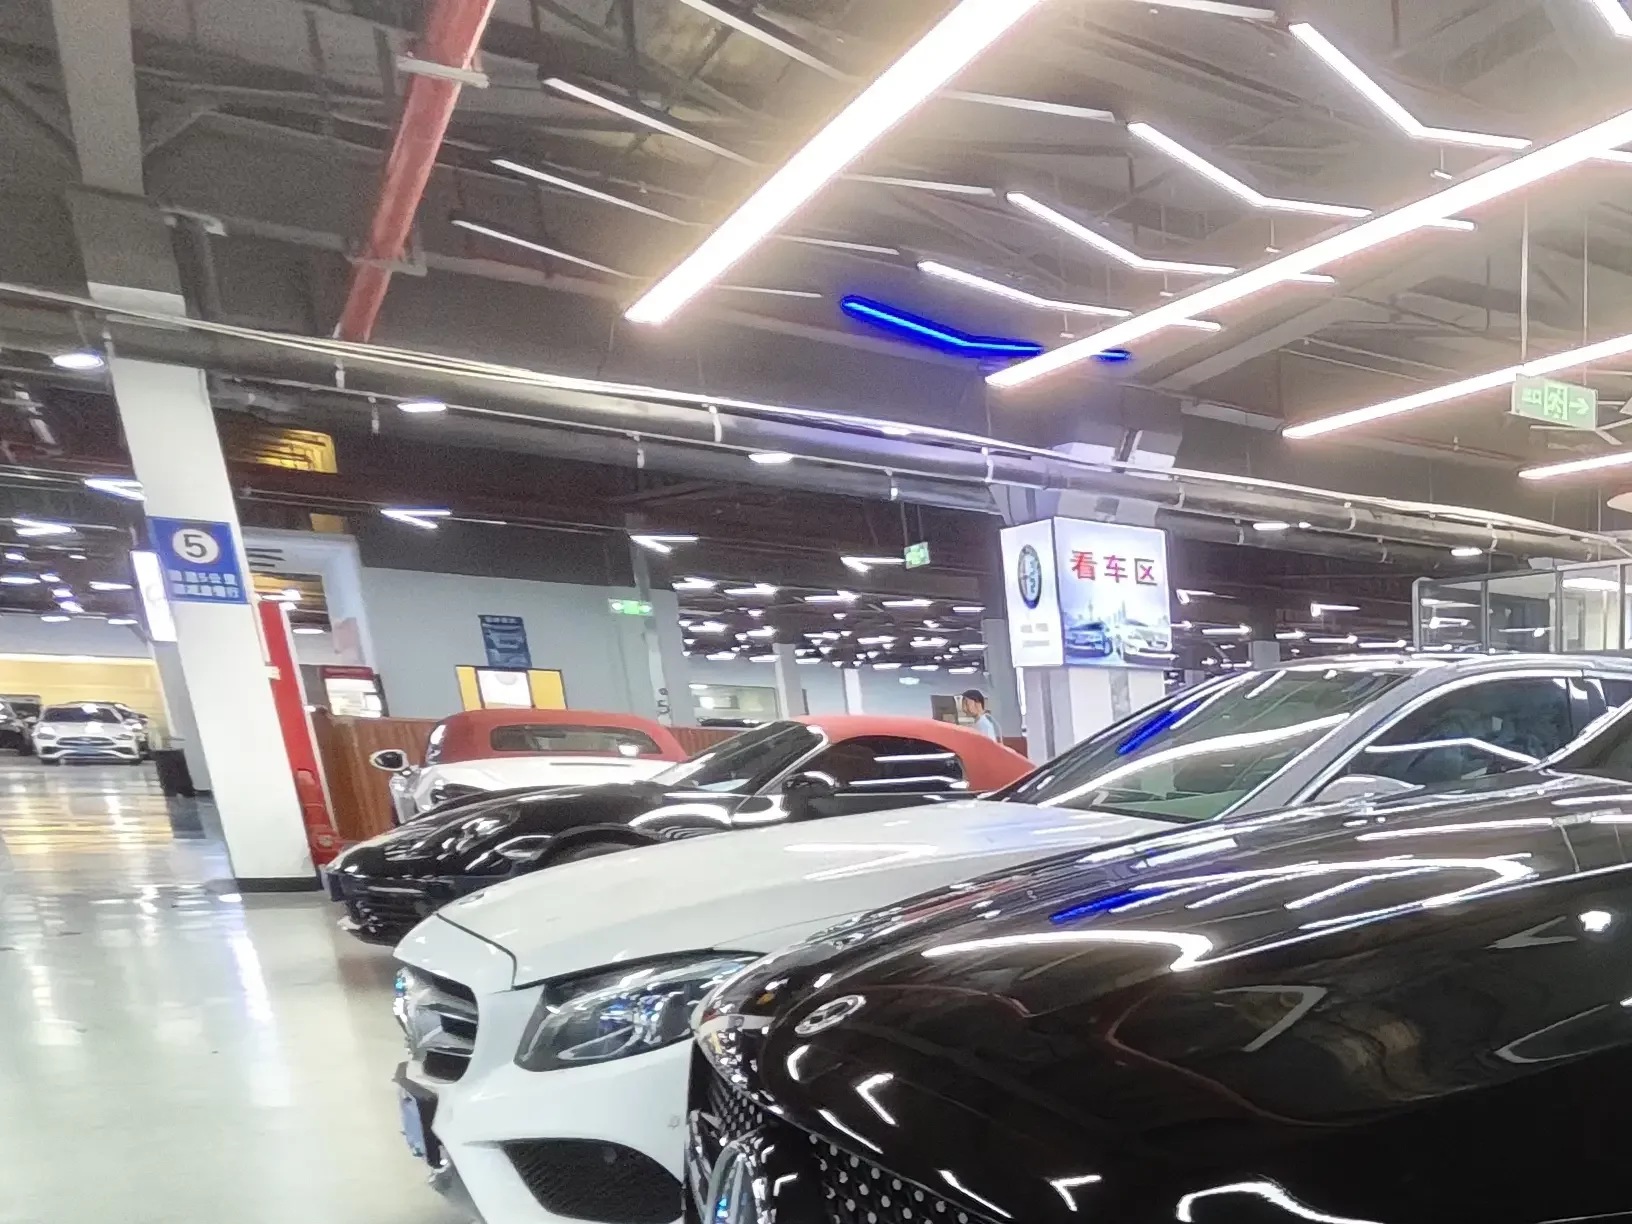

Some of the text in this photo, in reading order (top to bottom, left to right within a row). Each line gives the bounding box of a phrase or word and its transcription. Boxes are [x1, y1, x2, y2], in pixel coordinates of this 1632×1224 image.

[183, 533, 208, 559] 5
[1069, 549, 1159, 587] 看车区
